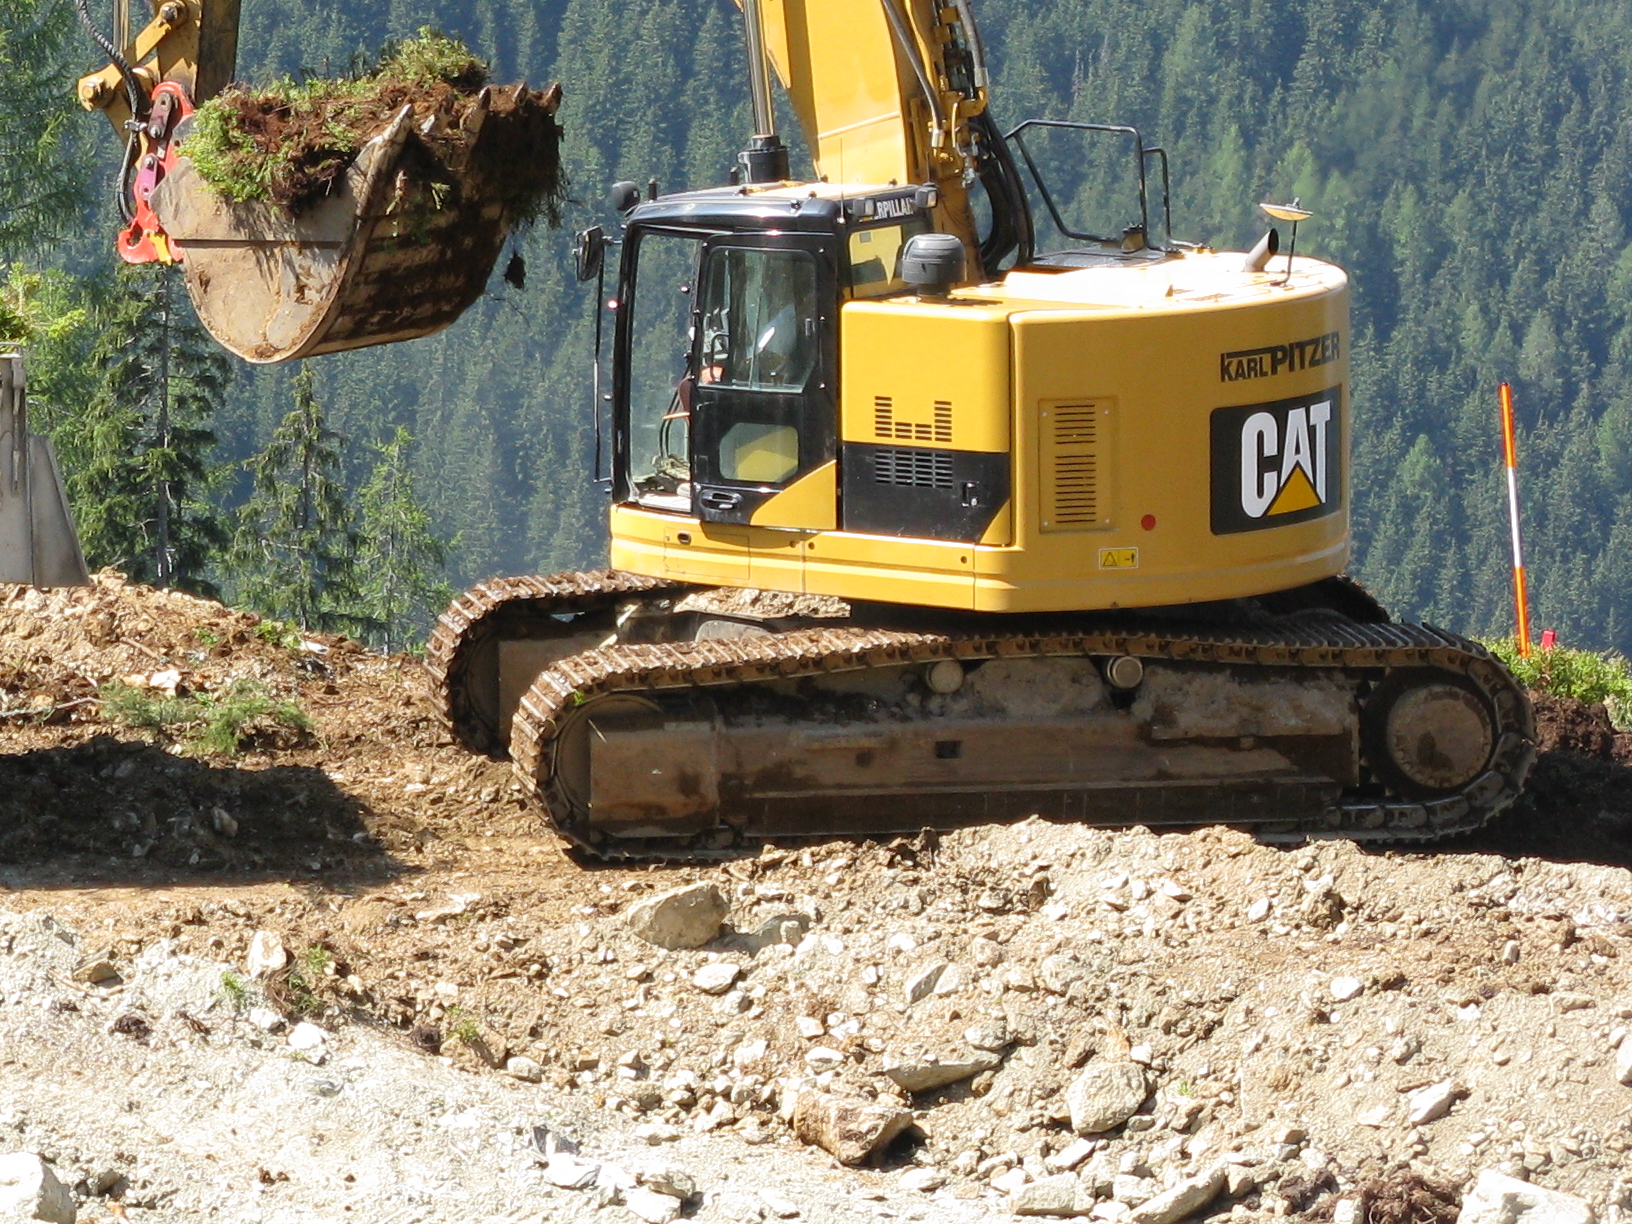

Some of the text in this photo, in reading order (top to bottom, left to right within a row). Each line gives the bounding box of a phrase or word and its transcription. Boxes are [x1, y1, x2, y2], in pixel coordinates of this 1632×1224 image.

[1221, 331, 1340, 382] KARL PITZER
[1241, 400, 1331, 518] CAT
